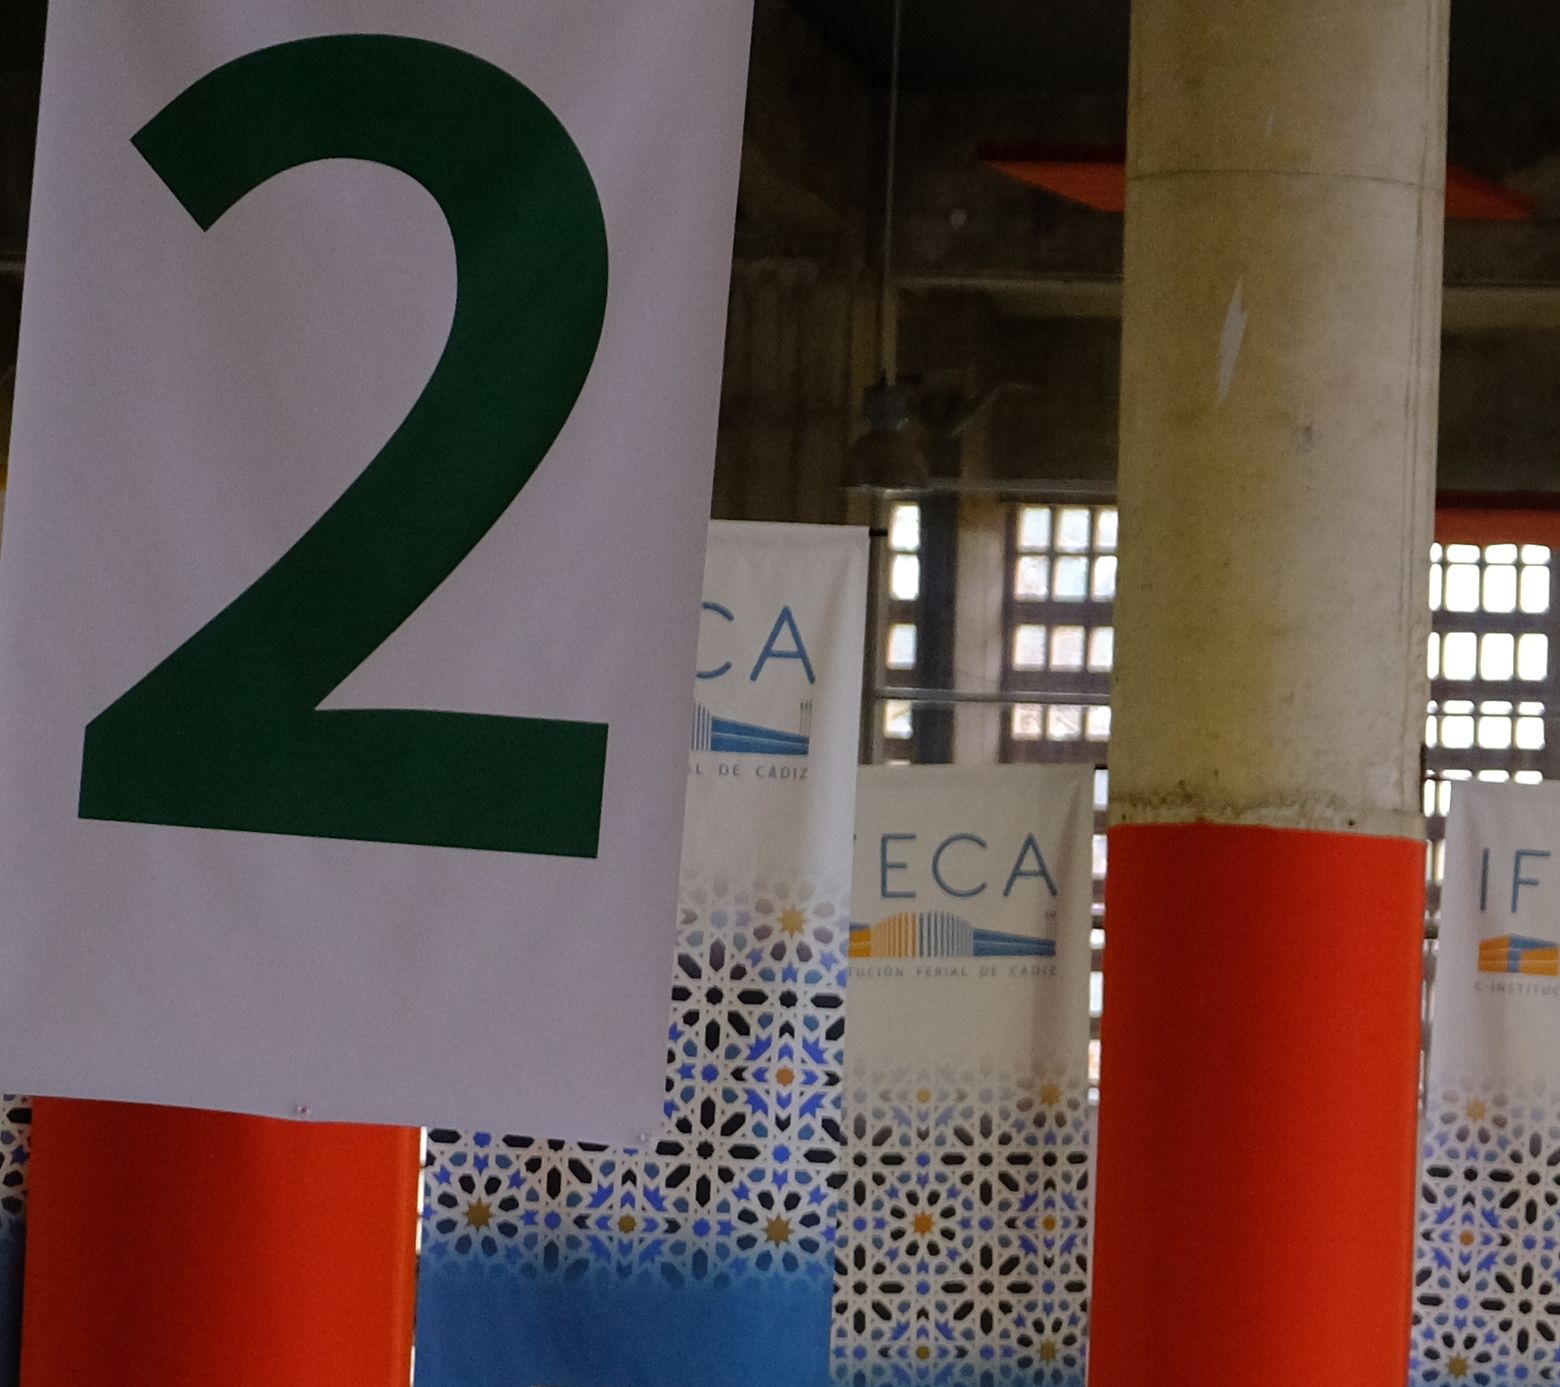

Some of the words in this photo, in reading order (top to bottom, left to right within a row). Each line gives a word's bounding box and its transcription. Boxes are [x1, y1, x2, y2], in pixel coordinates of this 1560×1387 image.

[78, 33, 609, 858] 2
[718, 763, 740, 776] DE
[854, 832, 1057, 899] ECA
